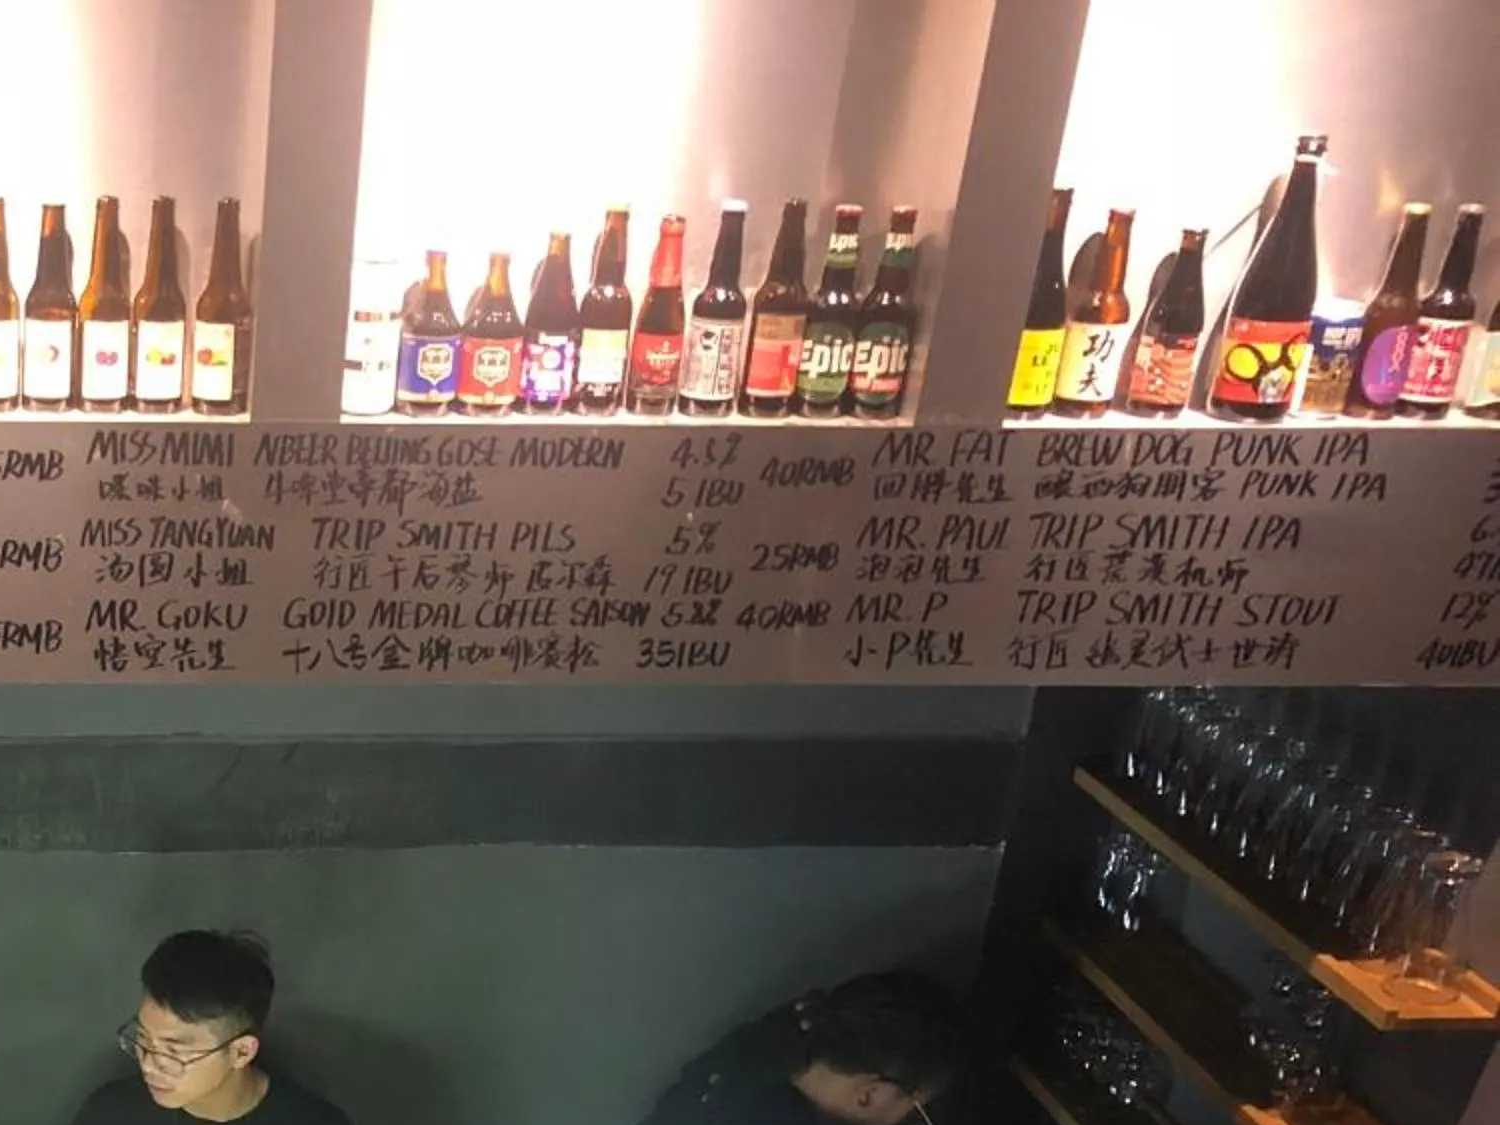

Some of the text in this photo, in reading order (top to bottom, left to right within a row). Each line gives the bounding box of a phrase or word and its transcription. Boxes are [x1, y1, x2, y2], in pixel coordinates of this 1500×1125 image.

[799, 335, 854, 379] Epic
[1077, 330, 1115, 397] 功夫
[1209, 431, 1304, 468] PUNK
[1312, 432, 1370, 467] IPA
[79, 515, 276, 551] MISS TANGYUAN
[310, 516, 578, 554] TRIP SMITH PILS
[1028, 511, 1303, 552] TRIP SMITH IPA
[156, 599, 249, 632] GOKU
[367, 597, 471, 631] MEDAL
[921, 591, 950, 624] P
[1016, 588, 1342, 628] TRIP SMITH STOUT
